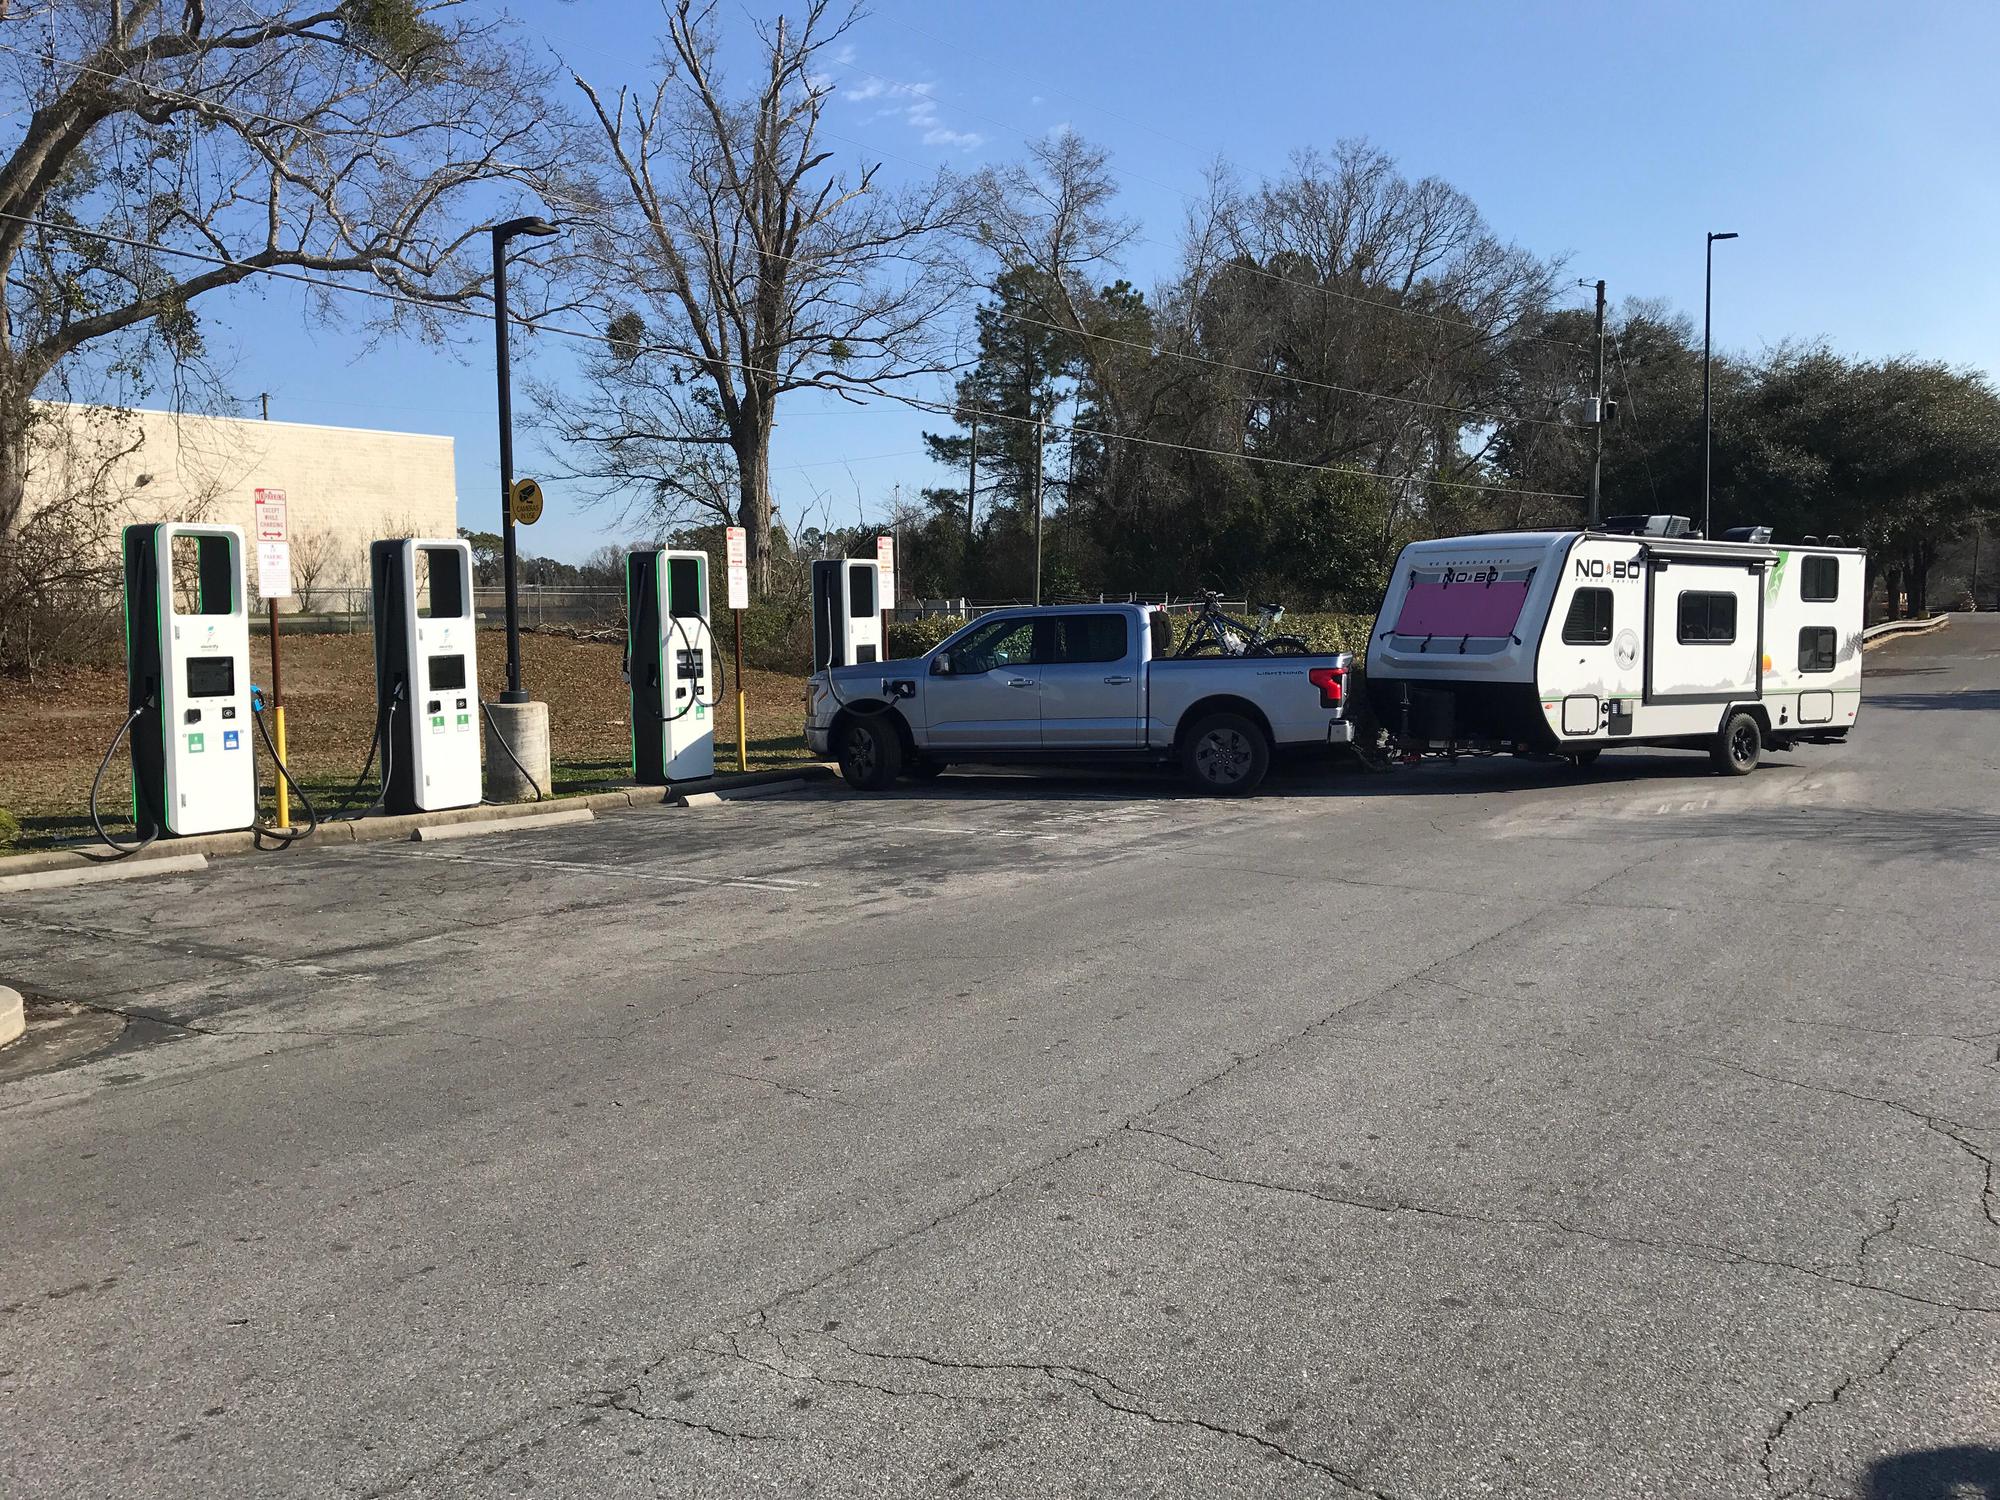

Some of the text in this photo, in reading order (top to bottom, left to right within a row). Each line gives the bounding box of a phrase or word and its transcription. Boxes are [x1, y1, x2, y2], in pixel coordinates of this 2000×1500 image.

[516, 504, 540, 512] CAMERAS
[1576, 558, 1640, 580] NO BO
[1442, 570, 1499, 583] NO BO
